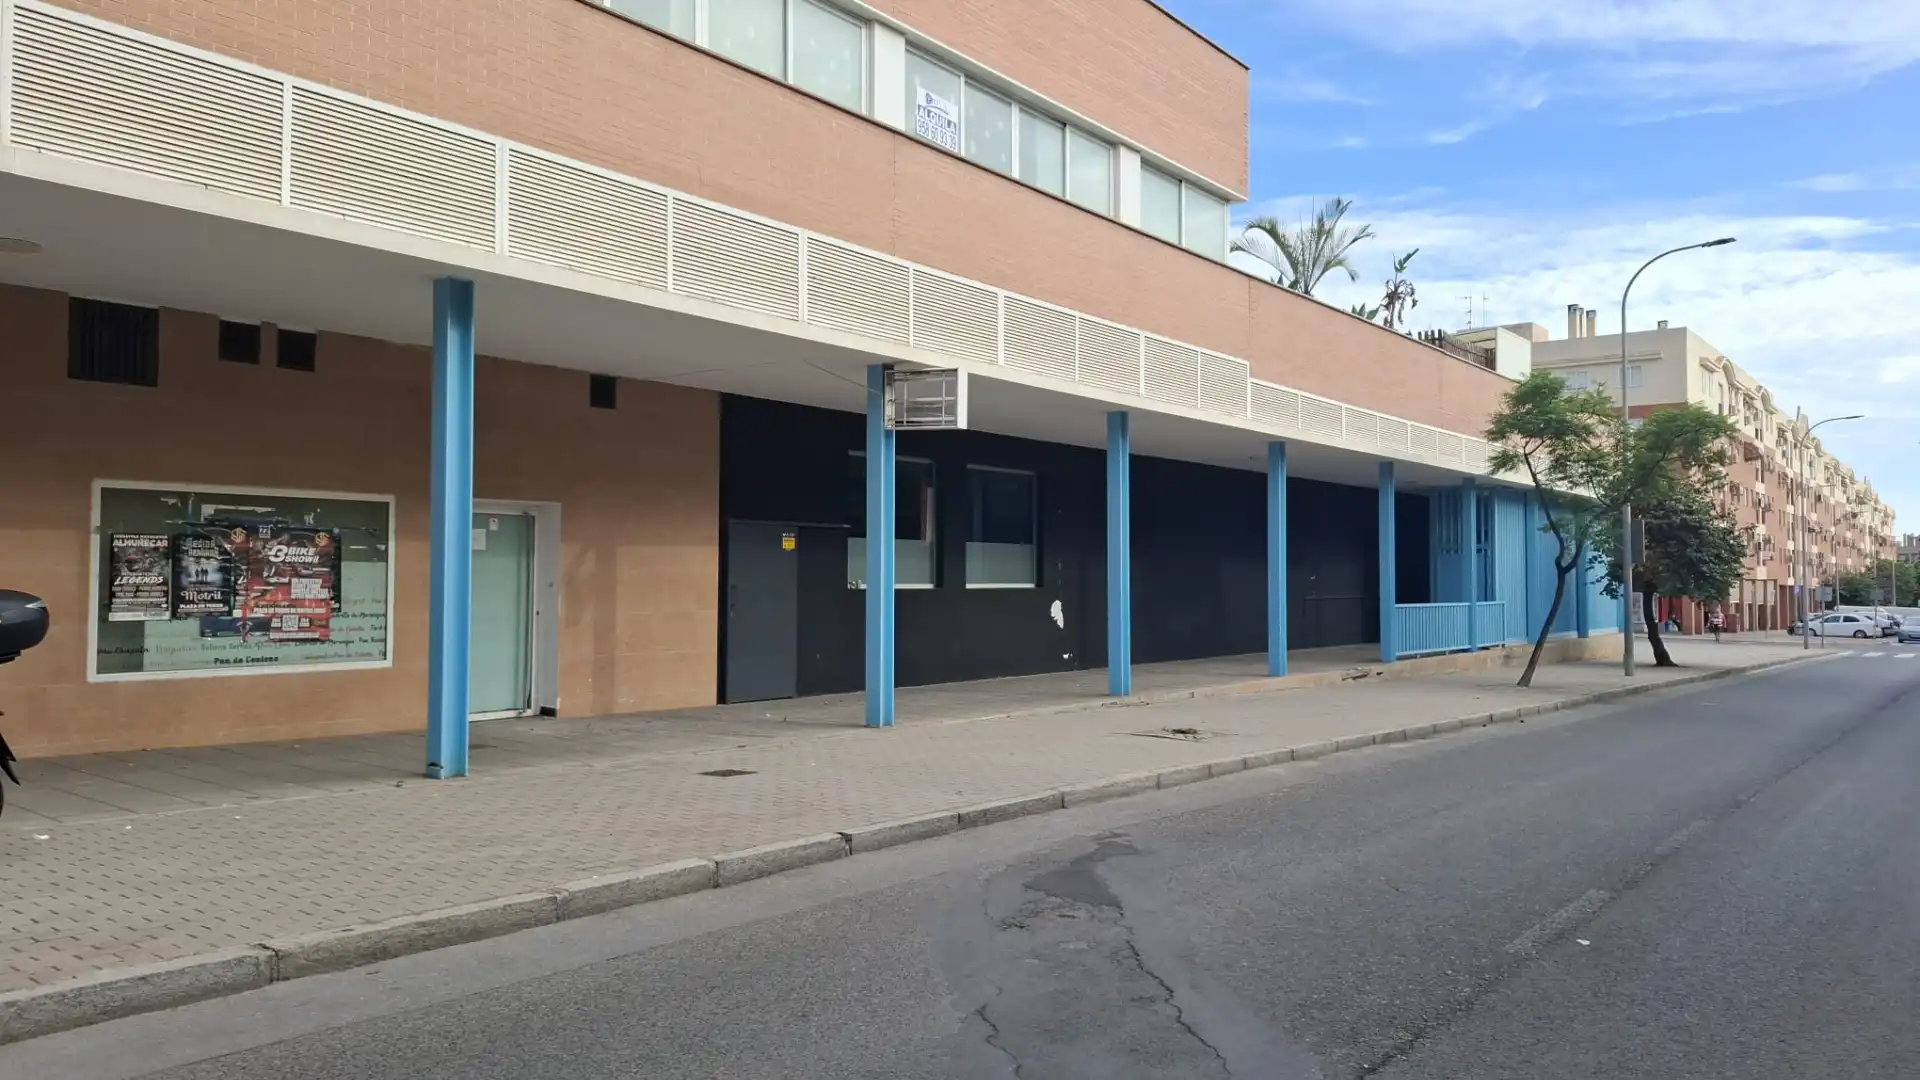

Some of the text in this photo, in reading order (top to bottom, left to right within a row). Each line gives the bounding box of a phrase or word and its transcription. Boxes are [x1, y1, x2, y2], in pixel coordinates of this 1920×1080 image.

[918, 105, 957, 135] ALQUILA
[918, 119, 930, 137] 958
[287, 547, 317, 555] BIKE
[114, 576, 164, 586] LEGENDS
[180, 590, 223, 603] Motril
